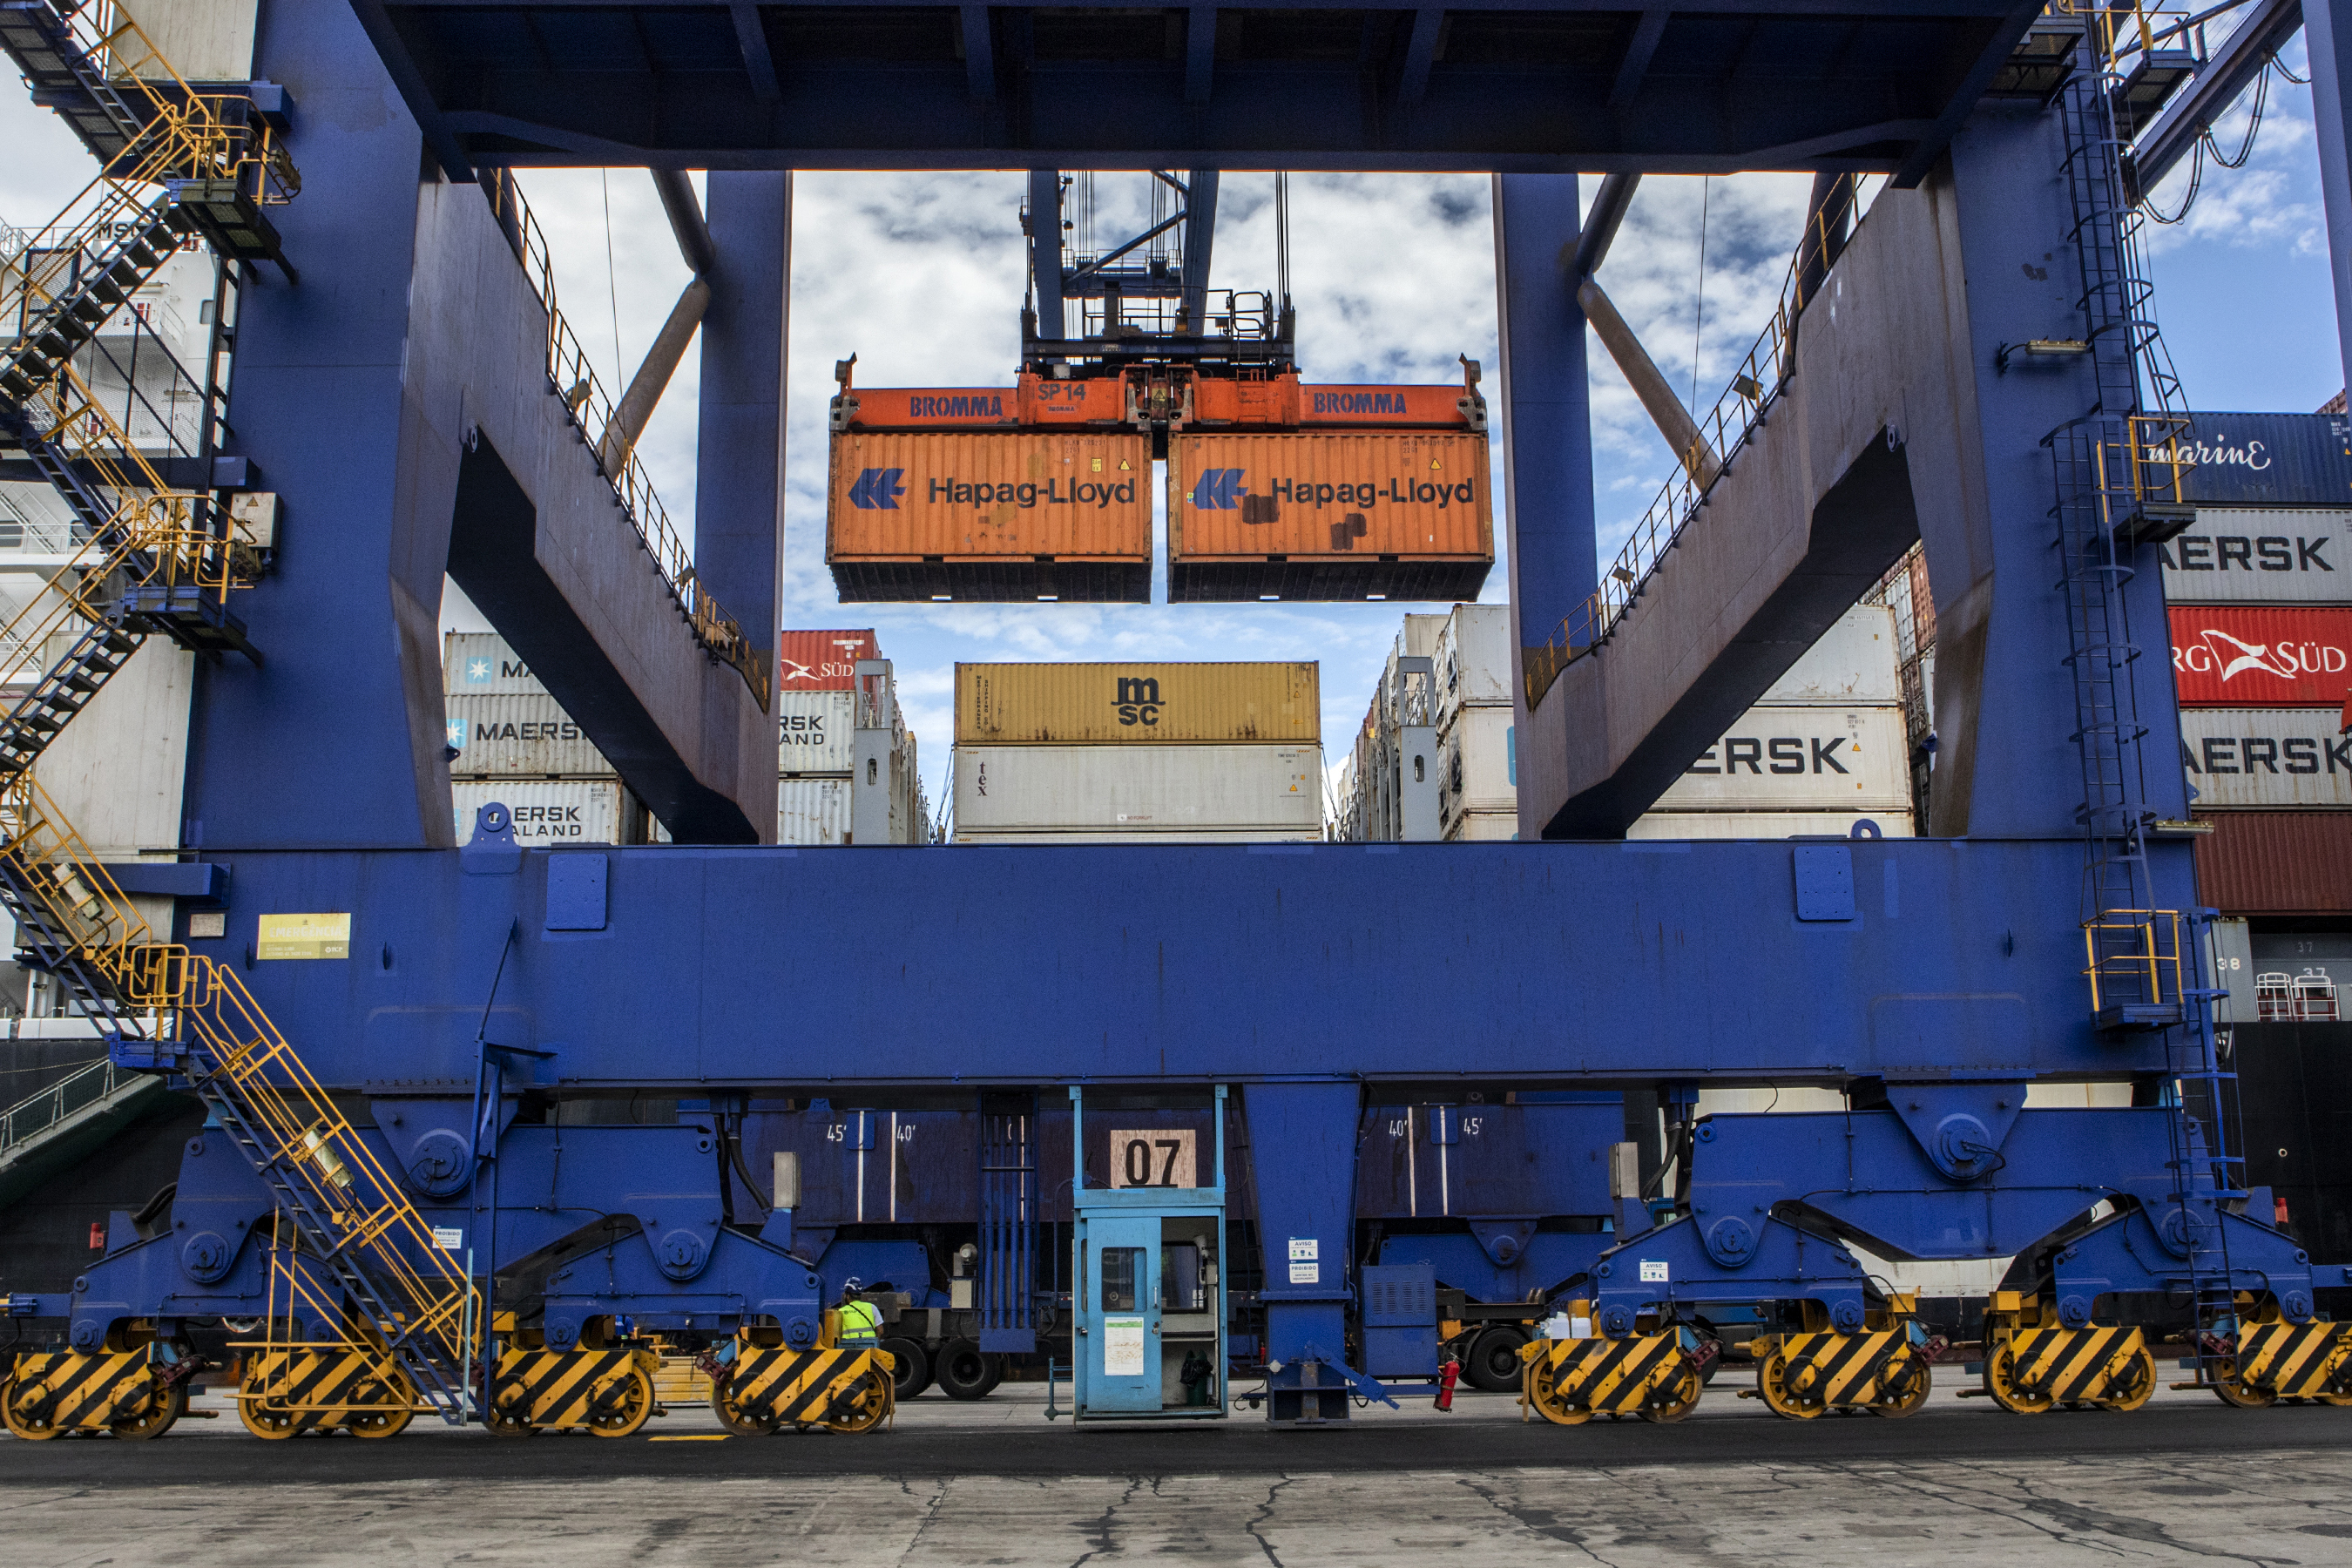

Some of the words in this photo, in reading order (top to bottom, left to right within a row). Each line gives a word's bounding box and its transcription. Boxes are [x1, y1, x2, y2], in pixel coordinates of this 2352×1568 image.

[910, 396, 1004, 417] BROMMA
[1313, 392, 1407, 414] BROMMA
[929, 477, 1135, 509] Hapag-Lloyd
[1271, 477, 1474, 509] Hapag-Lloyd
[2276, 641, 2347, 673] SÜD
[821, 661, 855, 677] SÜD
[476, 722, 591, 740] MAERS
[269, 923, 342, 938] EMERGÊNCIA
[2217, 958, 2240, 970] 38
[1125, 1139, 1181, 1185] 07
